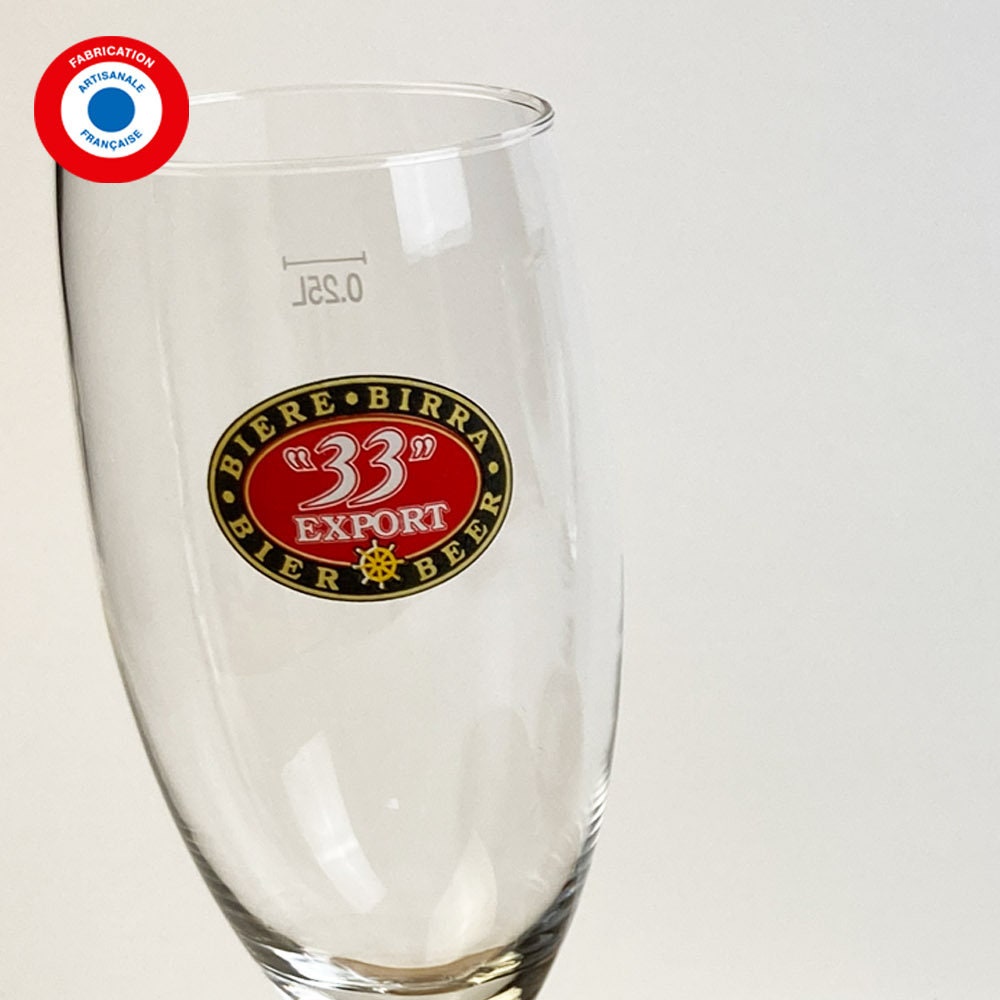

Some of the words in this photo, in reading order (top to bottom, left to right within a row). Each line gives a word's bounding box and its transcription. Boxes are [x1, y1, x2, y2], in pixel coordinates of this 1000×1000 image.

[220, 390, 335, 481] BIERE
[367, 385, 493, 453] BIRRA
[229, 513, 340, 592] BIER
[413, 491, 503, 582] BEER
[294, 502, 450, 543] EXPORT
